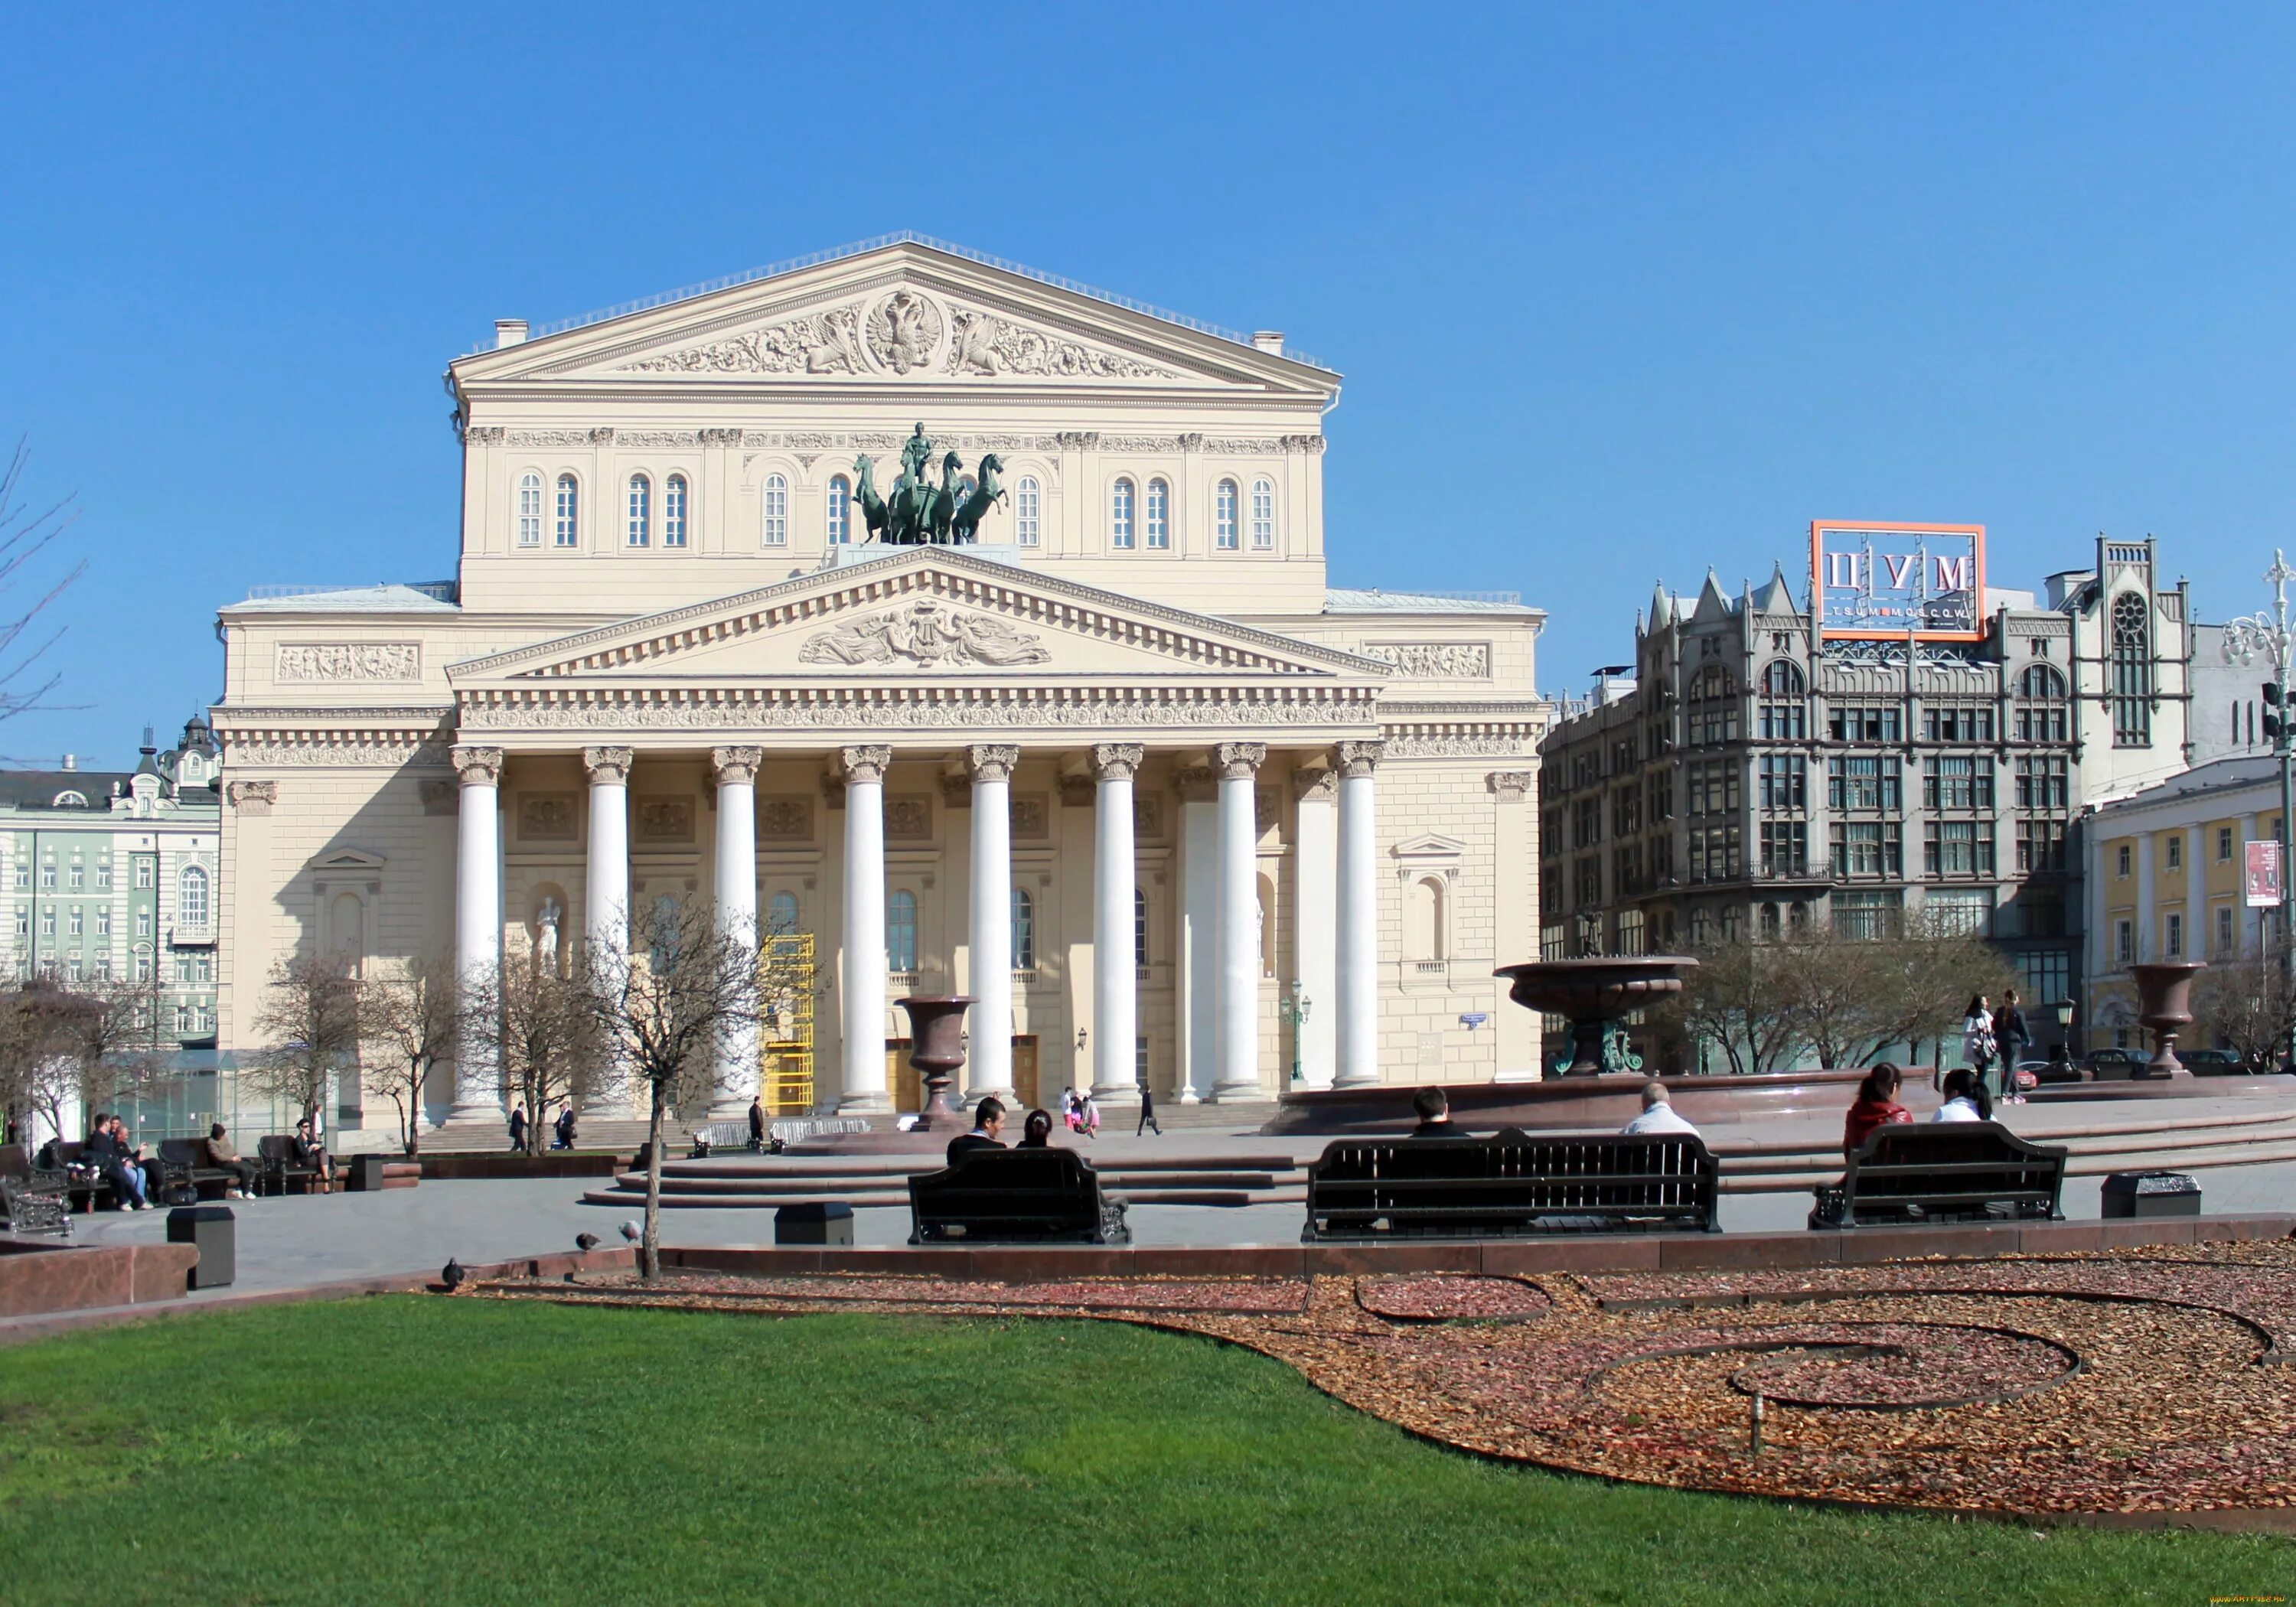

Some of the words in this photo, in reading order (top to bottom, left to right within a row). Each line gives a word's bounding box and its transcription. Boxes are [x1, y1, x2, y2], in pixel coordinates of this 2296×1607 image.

[1828, 553, 1971, 592] ЦУМ
[1833, 607, 1878, 617] TSUM
[1891, 607, 1965, 618] MOSCOW
